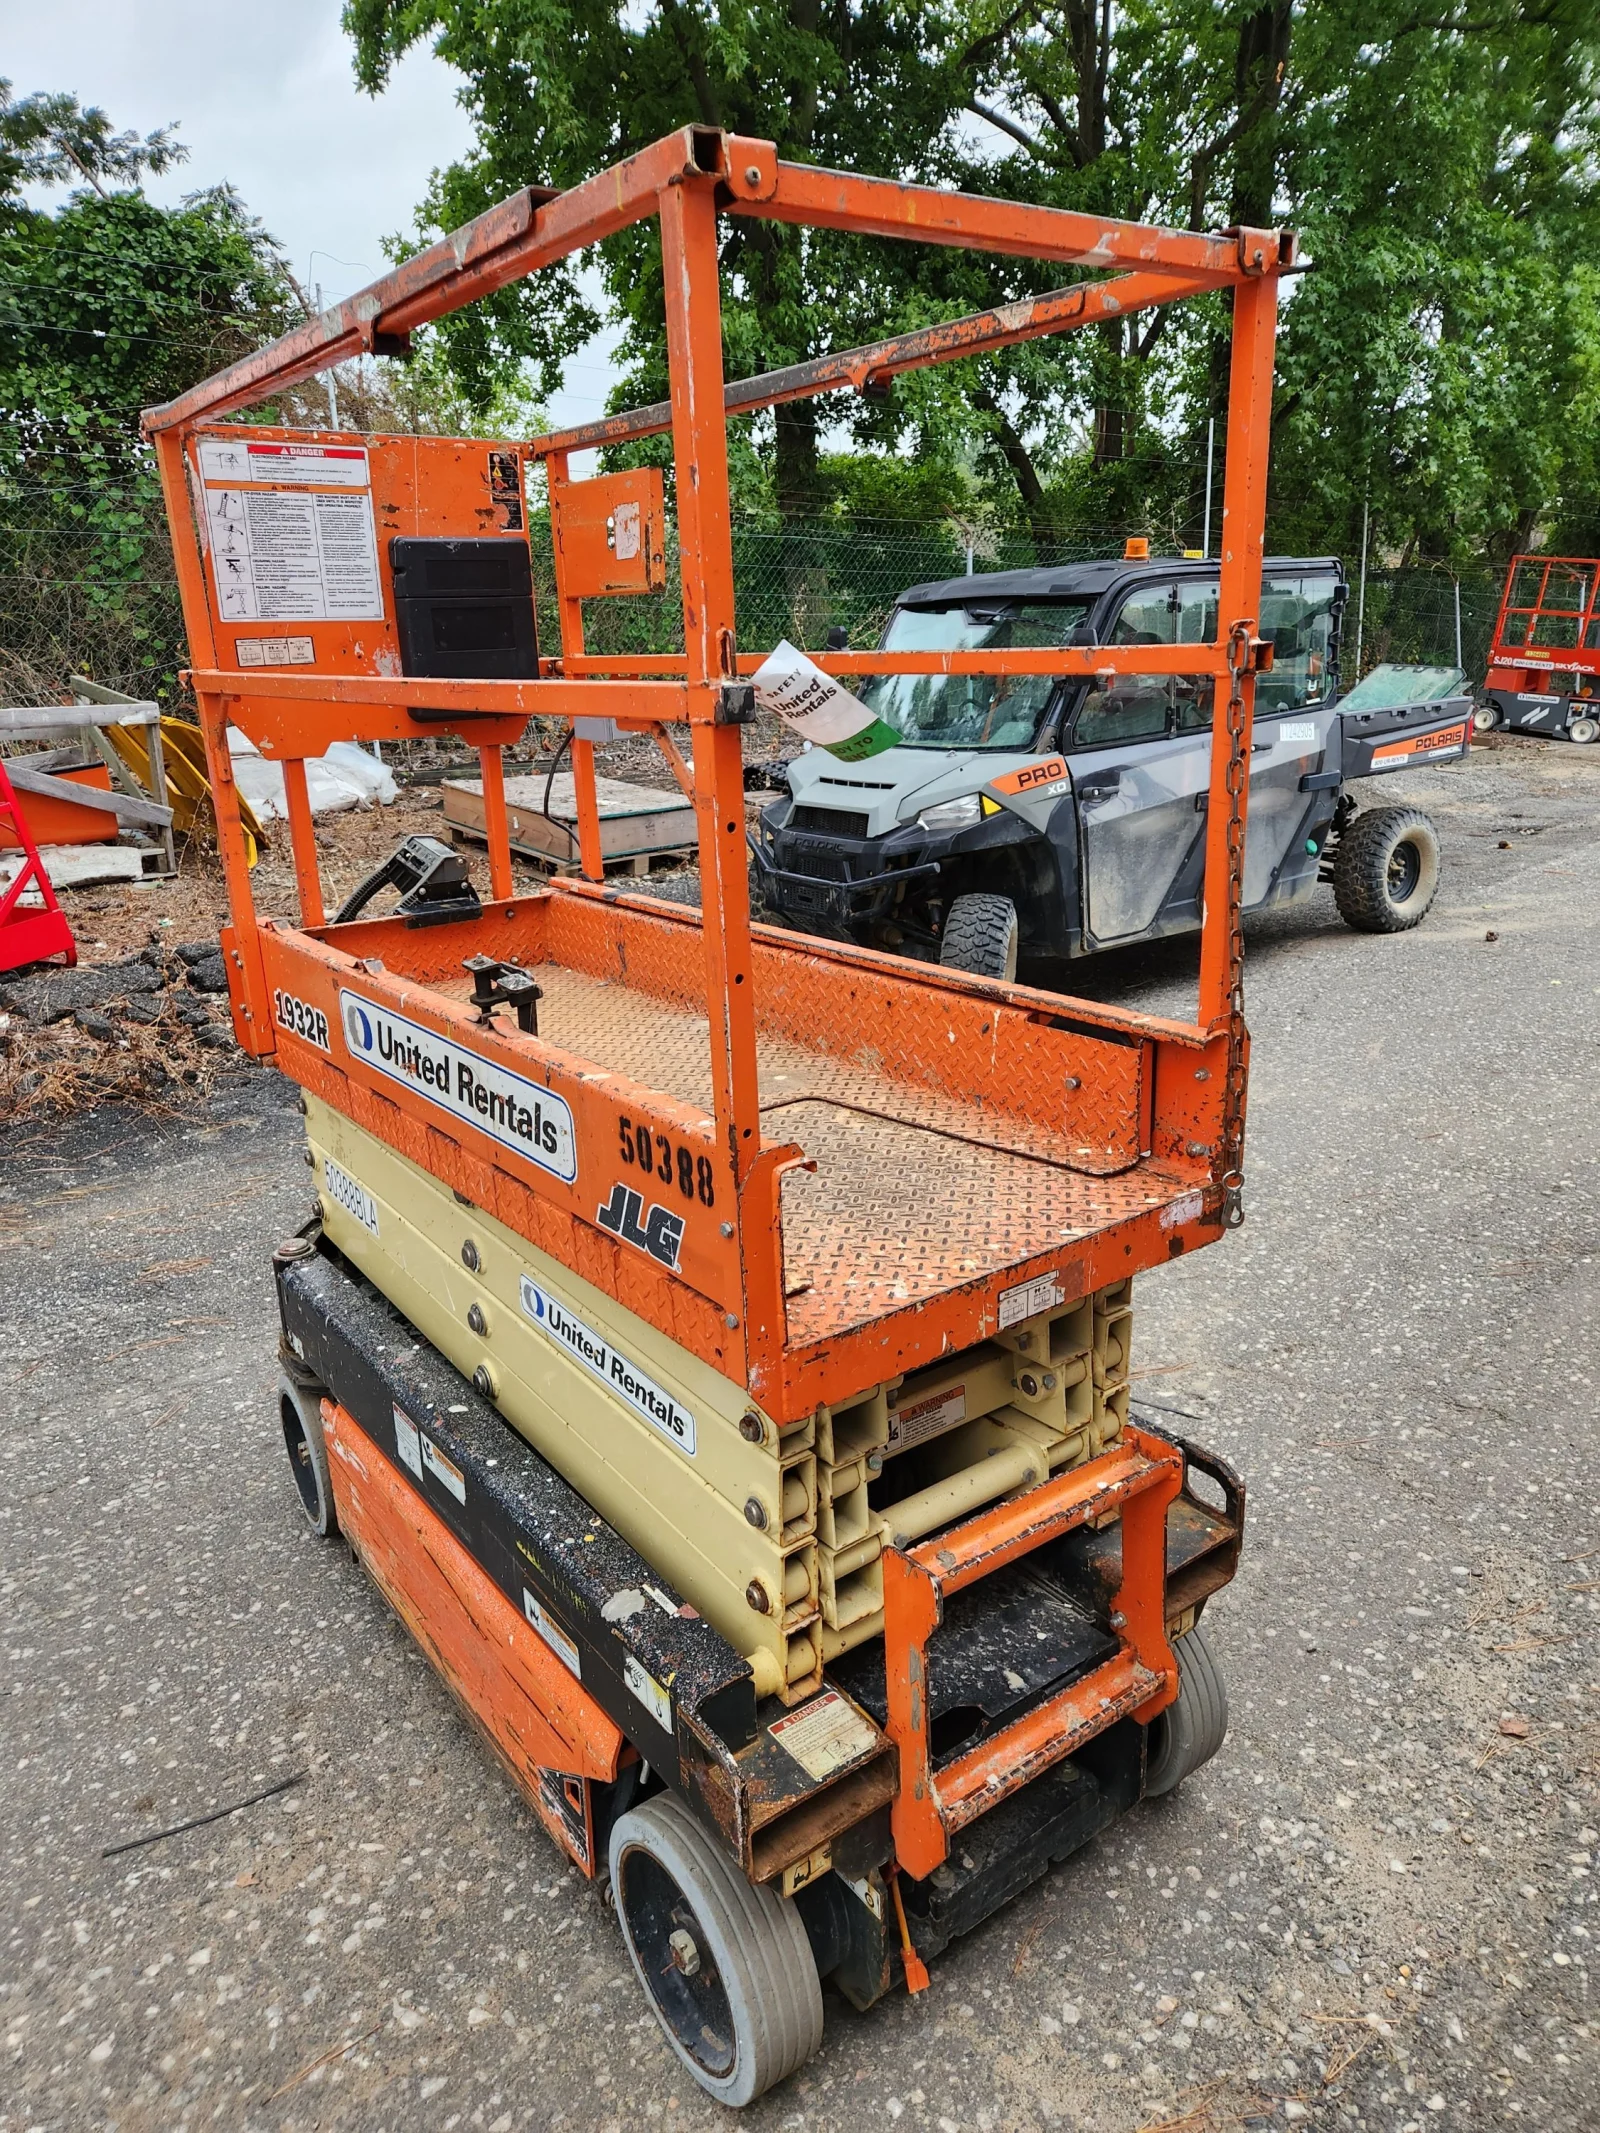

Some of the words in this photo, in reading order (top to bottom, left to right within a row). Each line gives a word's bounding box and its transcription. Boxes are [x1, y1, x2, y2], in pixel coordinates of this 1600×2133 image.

[289, 447, 325, 457] DANGER
[1493, 655, 1512, 666] SJ20
[1555, 661, 1596, 673] SKYJACK
[766, 668, 801, 698] SAFETY
[773, 677, 821, 711] United
[785, 686, 837, 719] Rentals
[853, 736, 874, 748] TO
[1415, 731, 1462, 750] POLARIS
[1017, 763, 1062, 787] PRO
[1047, 782, 1067, 795] XD
[274, 990, 330, 1051] 1932R
[376, 1020, 451, 1095] United
[457, 1061, 558, 1155] Rentals
[619, 1114, 715, 1208] 50388
[324, 1159, 379, 1236] 50388BLA
[595, 1181, 686, 1271] JLG
[548, 1303, 606, 1371] United
[610, 1355, 685, 1437] Rentals
[919, 1390, 955, 1412] WARNING
[791, 1699, 829, 1723] DANGER
